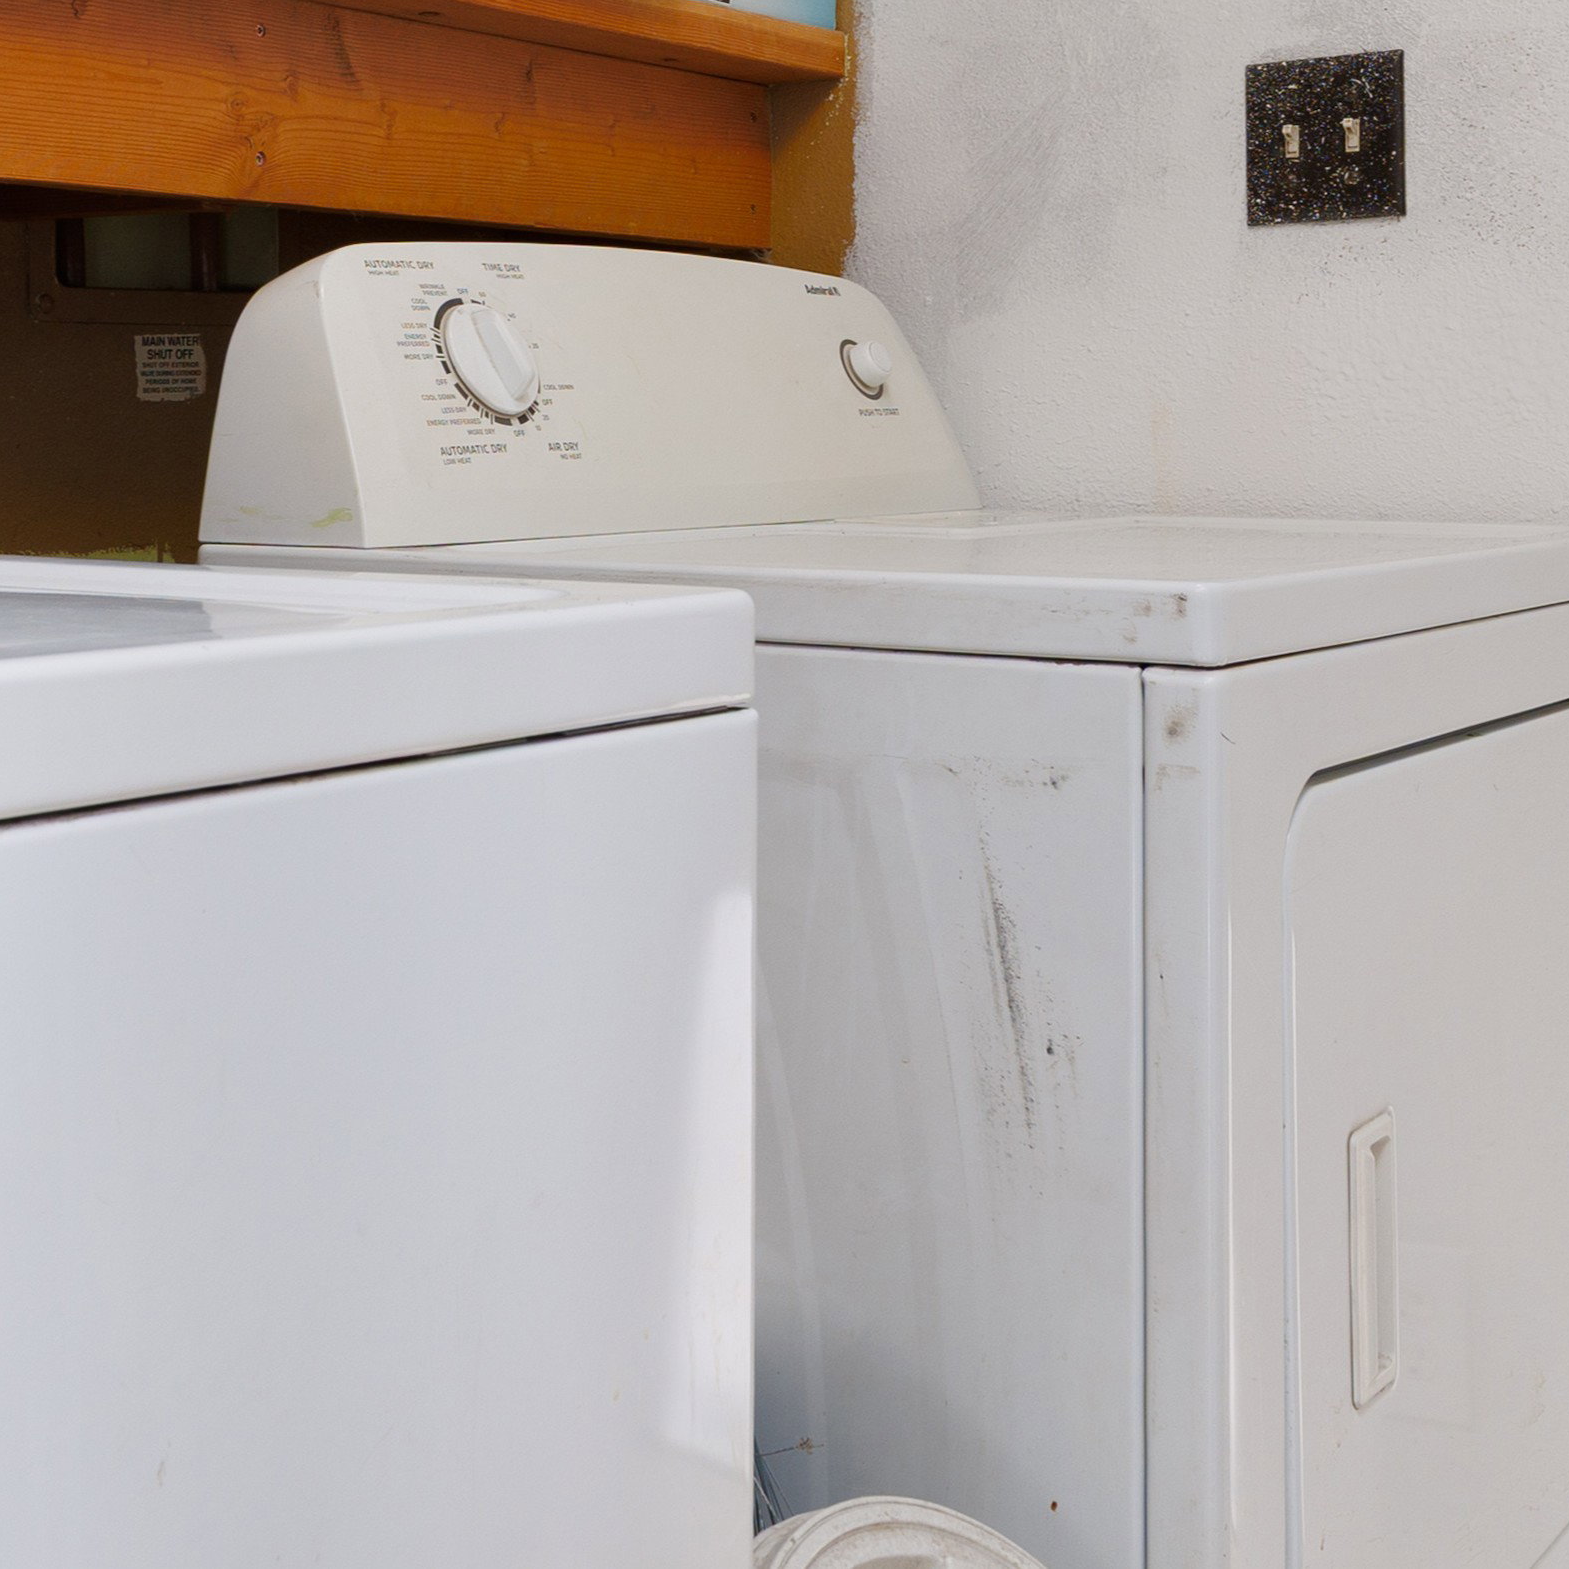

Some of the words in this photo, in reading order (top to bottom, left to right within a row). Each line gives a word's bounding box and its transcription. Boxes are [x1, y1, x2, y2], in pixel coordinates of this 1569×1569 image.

[364, 259, 416, 270] AUTOMATIC
[416, 261, 435, 270] DRY
[482, 262, 503, 272] TIME
[503, 263, 521, 273] DRY
[411, 297, 428, 305] COOL
[141, 336, 166, 347] MAIN
[166, 335, 199, 347] WATER
[147, 348, 172, 360] SHUT
[175, 348, 194, 360] OFF
[435, 378, 448, 386] OFF
[542, 398, 553, 406] OFF
[858, 408, 875, 417] PUSH
[874, 407, 883, 416] TO
[882, 407, 900, 416] START
[513, 429, 526, 437] OFF
[440, 444, 490, 456] AUTOMATIC
[490, 443, 508, 454] DRY
[548, 442, 562, 452] AIR
[562, 442, 579, 452] DRY
